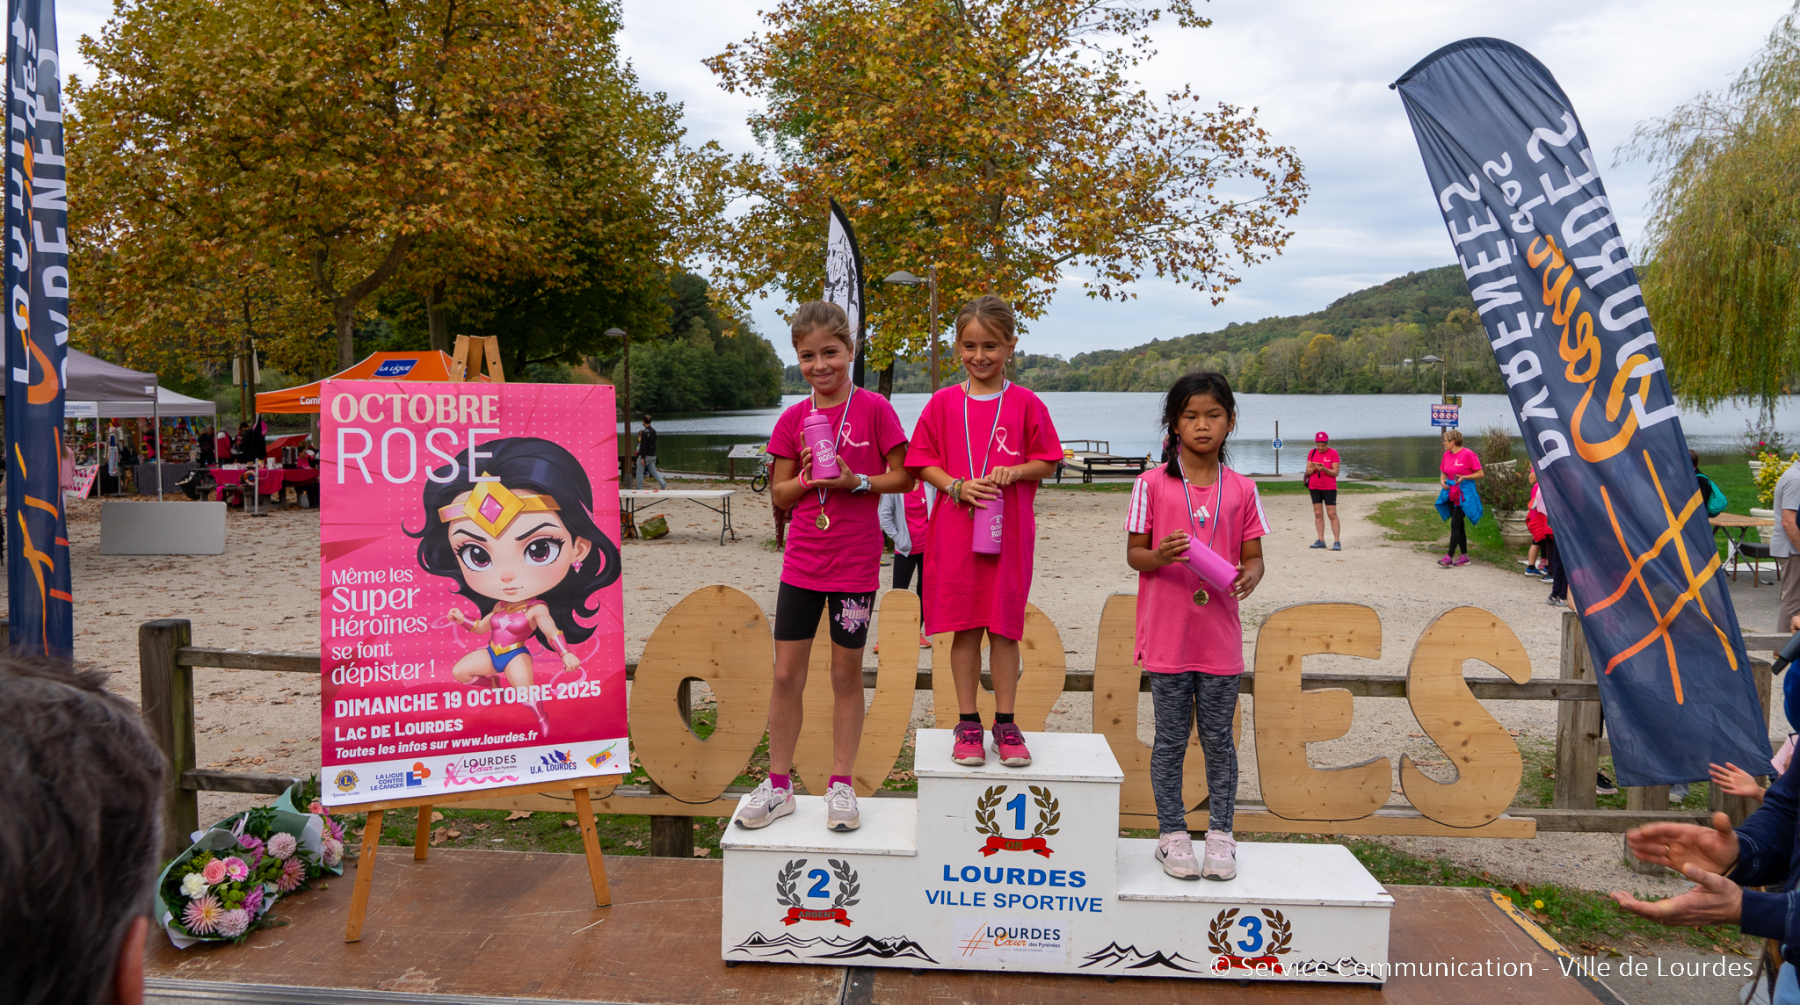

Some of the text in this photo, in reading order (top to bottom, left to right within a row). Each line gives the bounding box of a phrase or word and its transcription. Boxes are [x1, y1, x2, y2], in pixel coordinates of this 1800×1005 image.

[331, 393, 500, 424] OCTOBRE
[337, 427, 501, 484] ROSE
[818, 452, 835, 463] ROSE
[331, 567, 414, 585] Même les
[331, 586, 421, 616] Super
[331, 614, 428, 638] Héroïnes
[331, 640, 393, 661] se font
[331, 659, 435, 687] dépister !
[334, 680, 602, 718] DIMANCHE 19 OCTOBRE 2025
[335, 730, 539, 759] Toutes les infos sur www.lourdes.fr
[464, 755, 517, 768] LOURDES
[530, 762, 577, 774] U.A. LOURDES
[1006, 793, 1026, 830] 1
[1004, 841, 1023, 851] OR
[807, 869, 831, 899] 2
[943, 864, 1086, 888] LOURDES
[925, 890, 1103, 913] VILLE SPORTIVE
[987, 927, 1061, 941] LOURDES
[1237, 915, 1263, 952] 3
